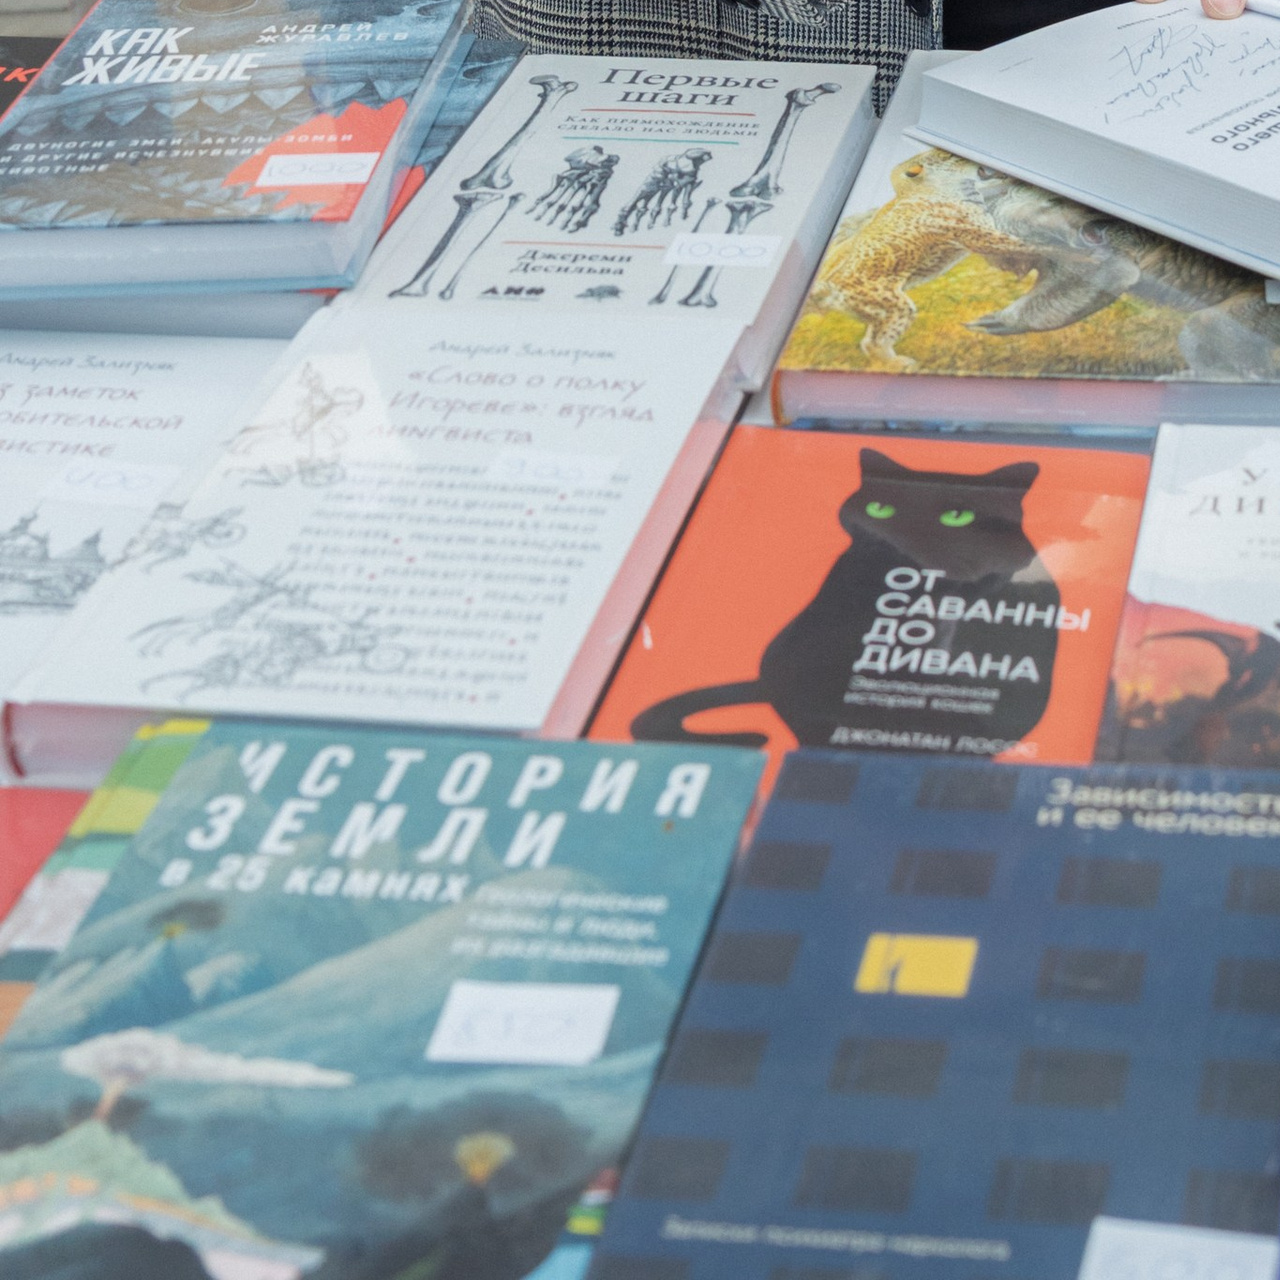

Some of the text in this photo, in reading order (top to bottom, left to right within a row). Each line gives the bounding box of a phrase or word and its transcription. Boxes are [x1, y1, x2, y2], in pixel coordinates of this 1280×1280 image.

[262, 21, 373, 33] АНДРЕЙ
[86, 27, 409, 56] КАК ЖУРАВЛЕВ
[61, 51, 268, 87] ЖИВЫЕ
[599, 67, 779, 91] Первые
[616, 89, 740, 107] шаги
[557, 124, 759, 137] СДЕЛАЛО НАС ЛЮДЬМИ
[564, 115, 760, 129] КАК ПРЯМОХОЖДЕНИЕ
[508, 261, 625, 276] Десильва
[516, 248, 633, 264] Джереми
[0, 439, 118, 457] истике
[884, 566, 946, 593] ОТ
[875, 591, 1092, 634] САВАННЫ
[861, 617, 936, 646] ДО
[851, 644, 1041, 684] ДИВАНА
[237, 739, 714, 819] ИСТОРИЯ
[1036, 804, 1063, 829] и
[185, 792, 569, 871] ЗЕМЛИ
[158, 853, 471, 905] в 25 камнях
